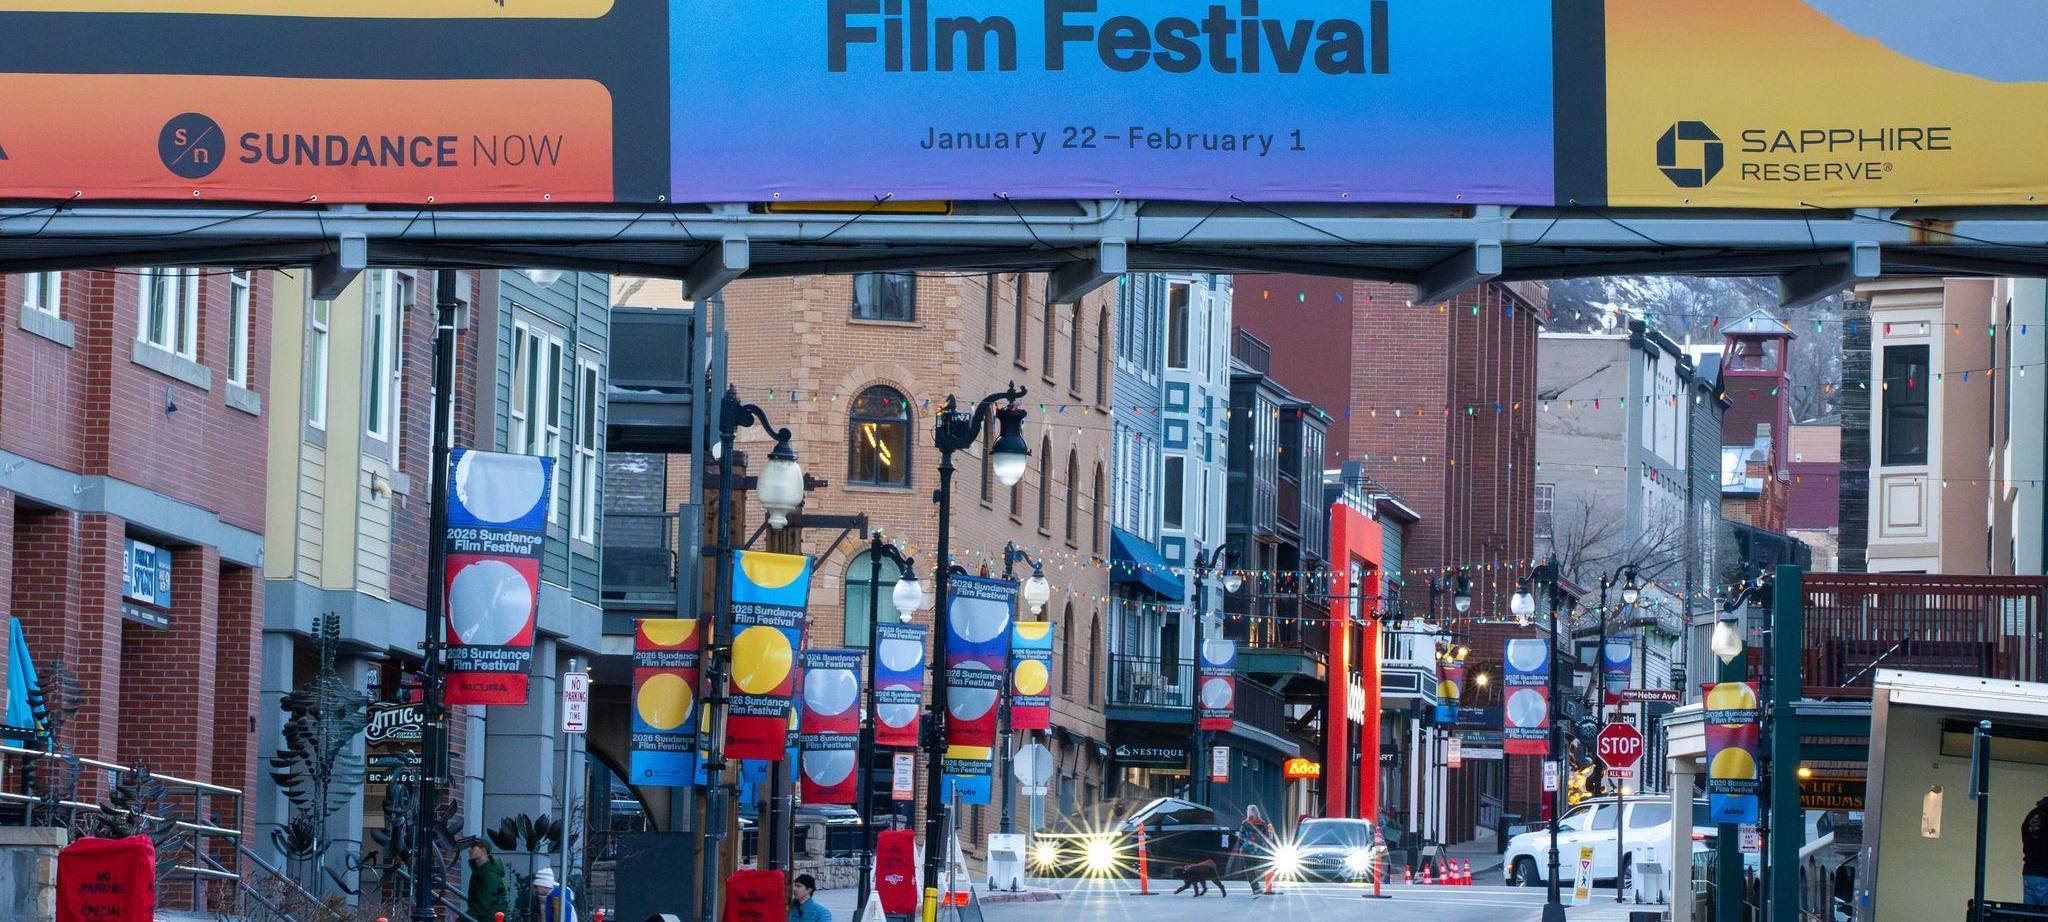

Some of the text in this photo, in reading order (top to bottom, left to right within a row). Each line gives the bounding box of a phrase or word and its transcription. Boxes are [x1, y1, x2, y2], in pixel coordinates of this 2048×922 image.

[827, 0, 1389, 74] Film Festival
[919, 125, 1047, 155] January
[1291, 136, 1305, 151] 1
[1741, 127, 1952, 153] SAPPHIRE
[239, 132, 563, 167] SUNDANCE NOW
[447, 528, 542, 546] 2026 Sundance
[455, 540, 532, 555] Film Festival
[951, 578, 1018, 595] 2026 Sundance
[957, 587, 1009, 601] Film Festival
[730, 604, 804, 619] 2026 Sundance
[735, 613, 796, 627] Film Festival
[470, 649, 531, 661] Sundance
[635, 651, 699, 661] 2026 Sundance
[806, 653, 861, 662] 026 Sundance
[453, 660, 521, 672] Film Festival
[641, 659, 692, 668] Film Festival
[807, 660, 855, 669] Film Festival
[961, 670, 1002, 681] Sundance
[571, 679, 581, 690] NO
[947, 677, 996, 688] Film Festival
[564, 691, 587, 702] PARKING
[1638, 690, 1660, 700] Heber
[1661, 691, 1678, 701] Ave.
[570, 703, 581, 711] ANY
[729, 695, 791, 708] 026 Sundance
[729, 704, 781, 716] Film Festival
[569, 711, 581, 721] TIME
[632, 733, 655, 742] 2026
[654, 734, 695, 744] Sundance
[819, 734, 858, 743] Sundance
[638, 741, 690, 751] Film Festival
[806, 741, 852, 749] Film Festival
[1600, 736, 1641, 755] STOP
[1132, 748, 1185, 758] NESTIQUE
[1288, 762, 1321, 775] Adob
[1609, 769, 1619, 778] ALL
[1813, 782, 1844, 793] LIFT
